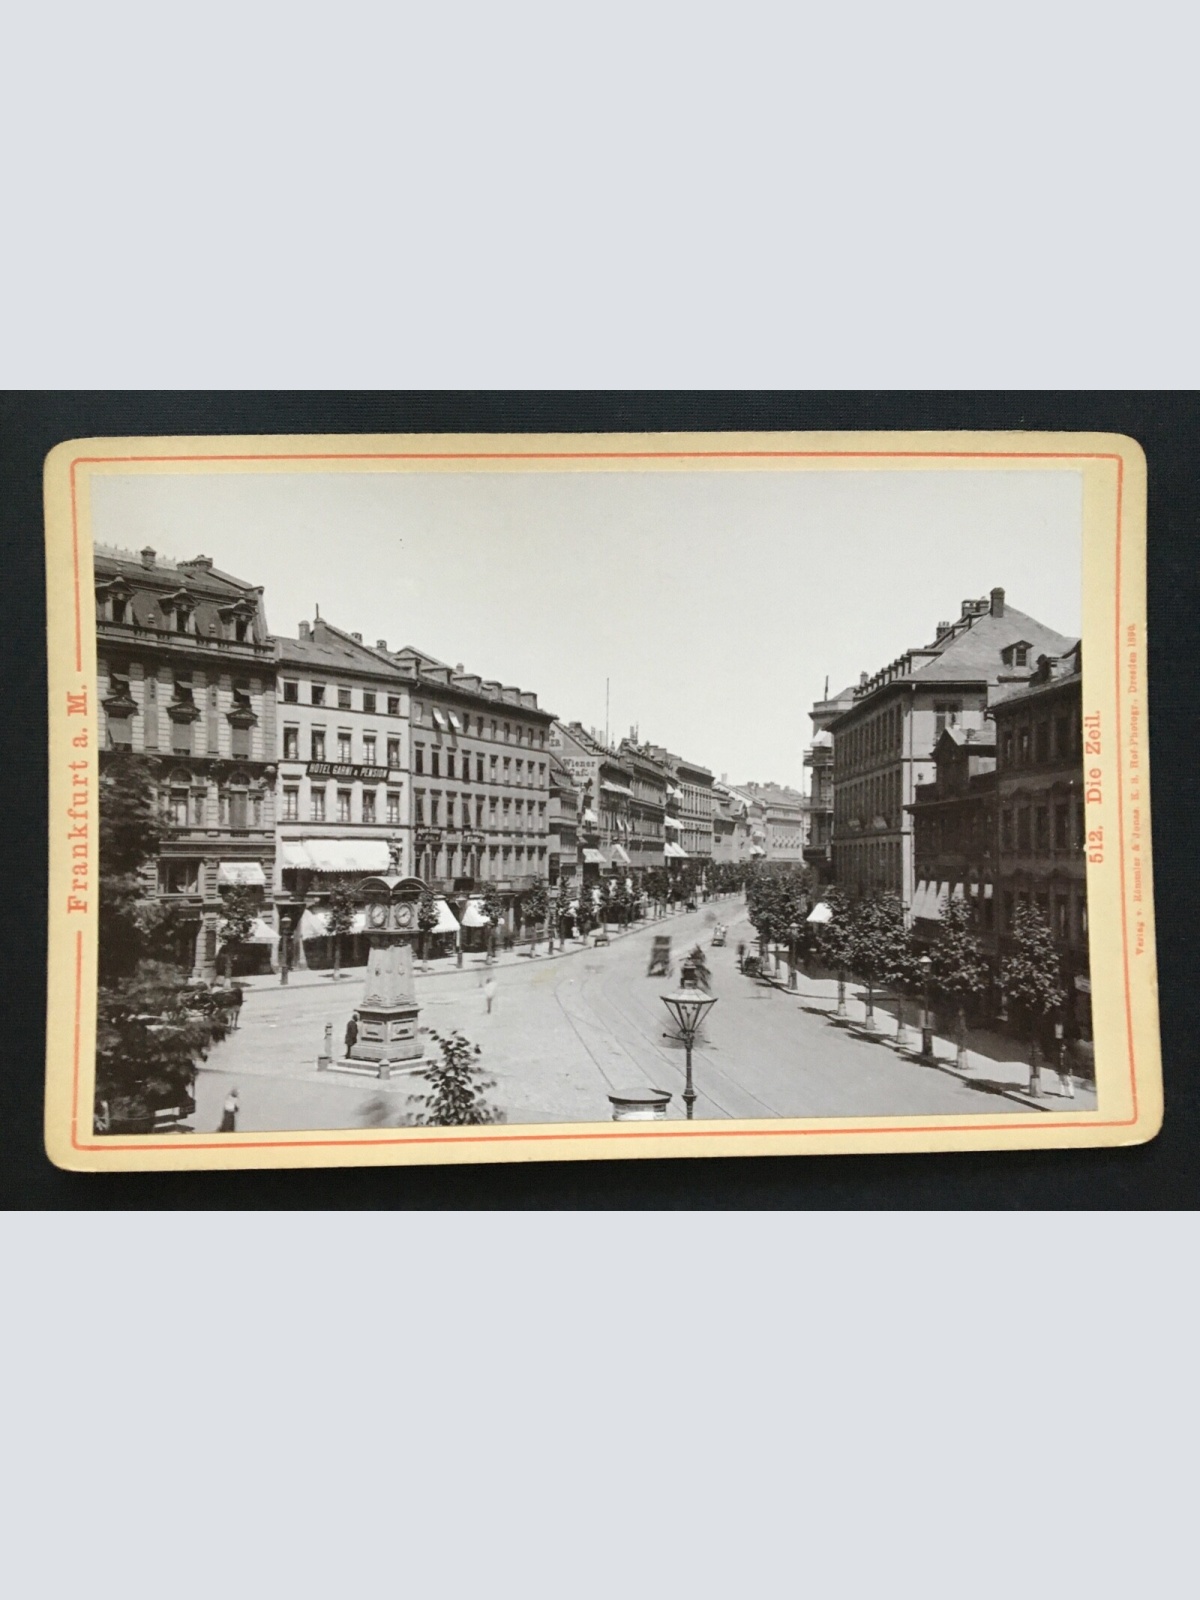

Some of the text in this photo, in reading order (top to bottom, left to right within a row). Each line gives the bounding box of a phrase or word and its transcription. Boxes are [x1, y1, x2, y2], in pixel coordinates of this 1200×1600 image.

[1128, 652, 1138, 693] Dresden
[332, 765, 353, 775] GARNI
[360, 767, 388, 778] PENSION
[563, 758, 596, 767] Wiener
[66, 684, 89, 914] Frankfurt a. M.
[1084, 710, 1104, 864] 512. Die Zeil.
[1132, 844, 1141, 852] &
